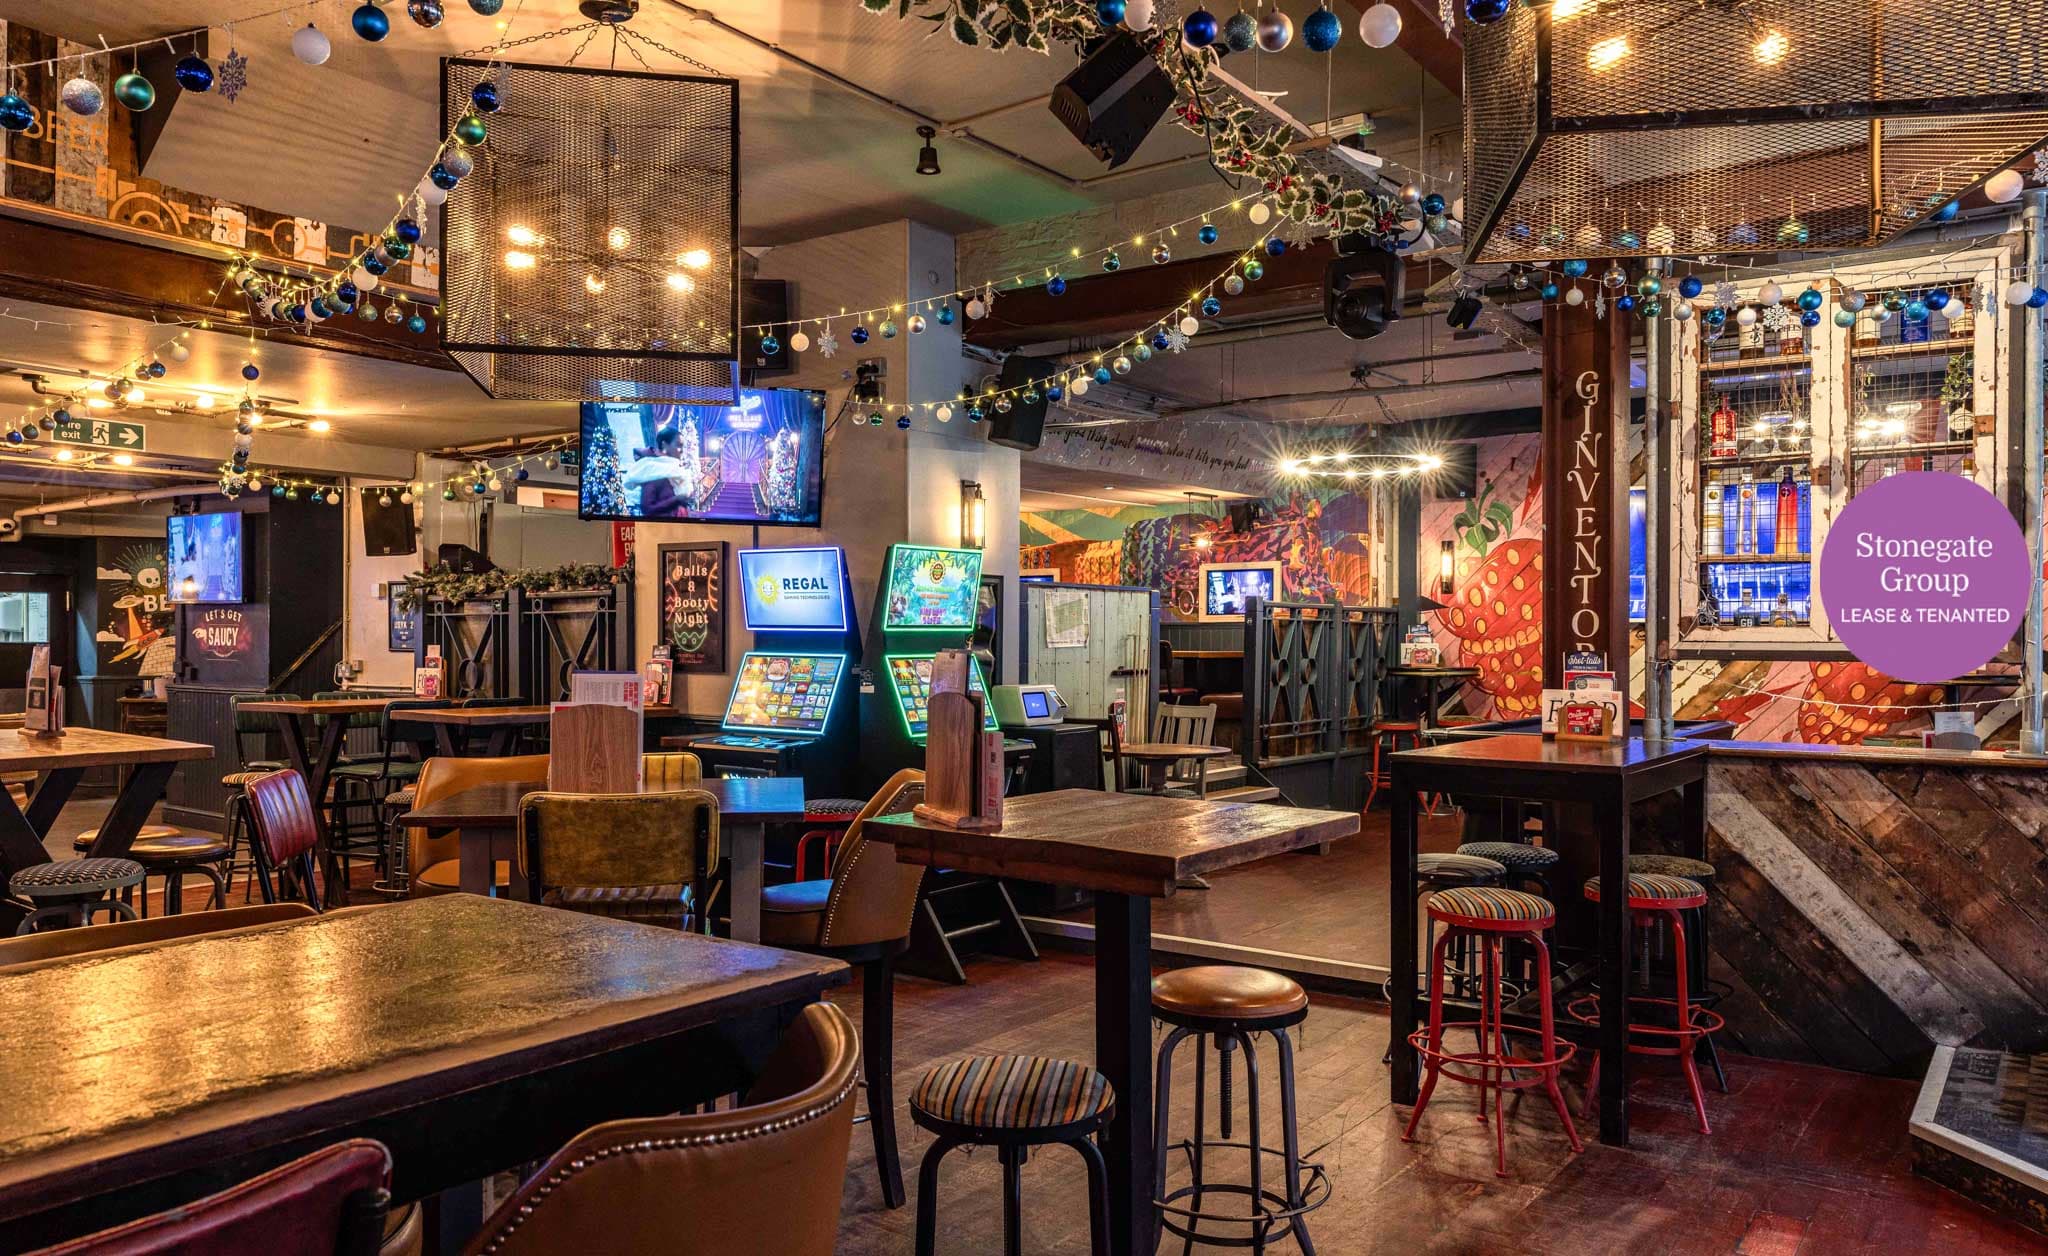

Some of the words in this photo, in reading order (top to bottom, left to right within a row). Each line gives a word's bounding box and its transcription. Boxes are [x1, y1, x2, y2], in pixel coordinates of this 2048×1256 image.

[23, 105, 108, 155] BEER
[61, 430, 81, 440] exit
[675, 564, 708, 577] Balls
[687, 580, 695, 592] &
[782, 577, 829, 590] REGAL
[674, 596, 710, 611] Booty
[227, 610, 242, 623] GET
[674, 612, 709, 628] Night
[208, 627, 239, 647] SAUCY
